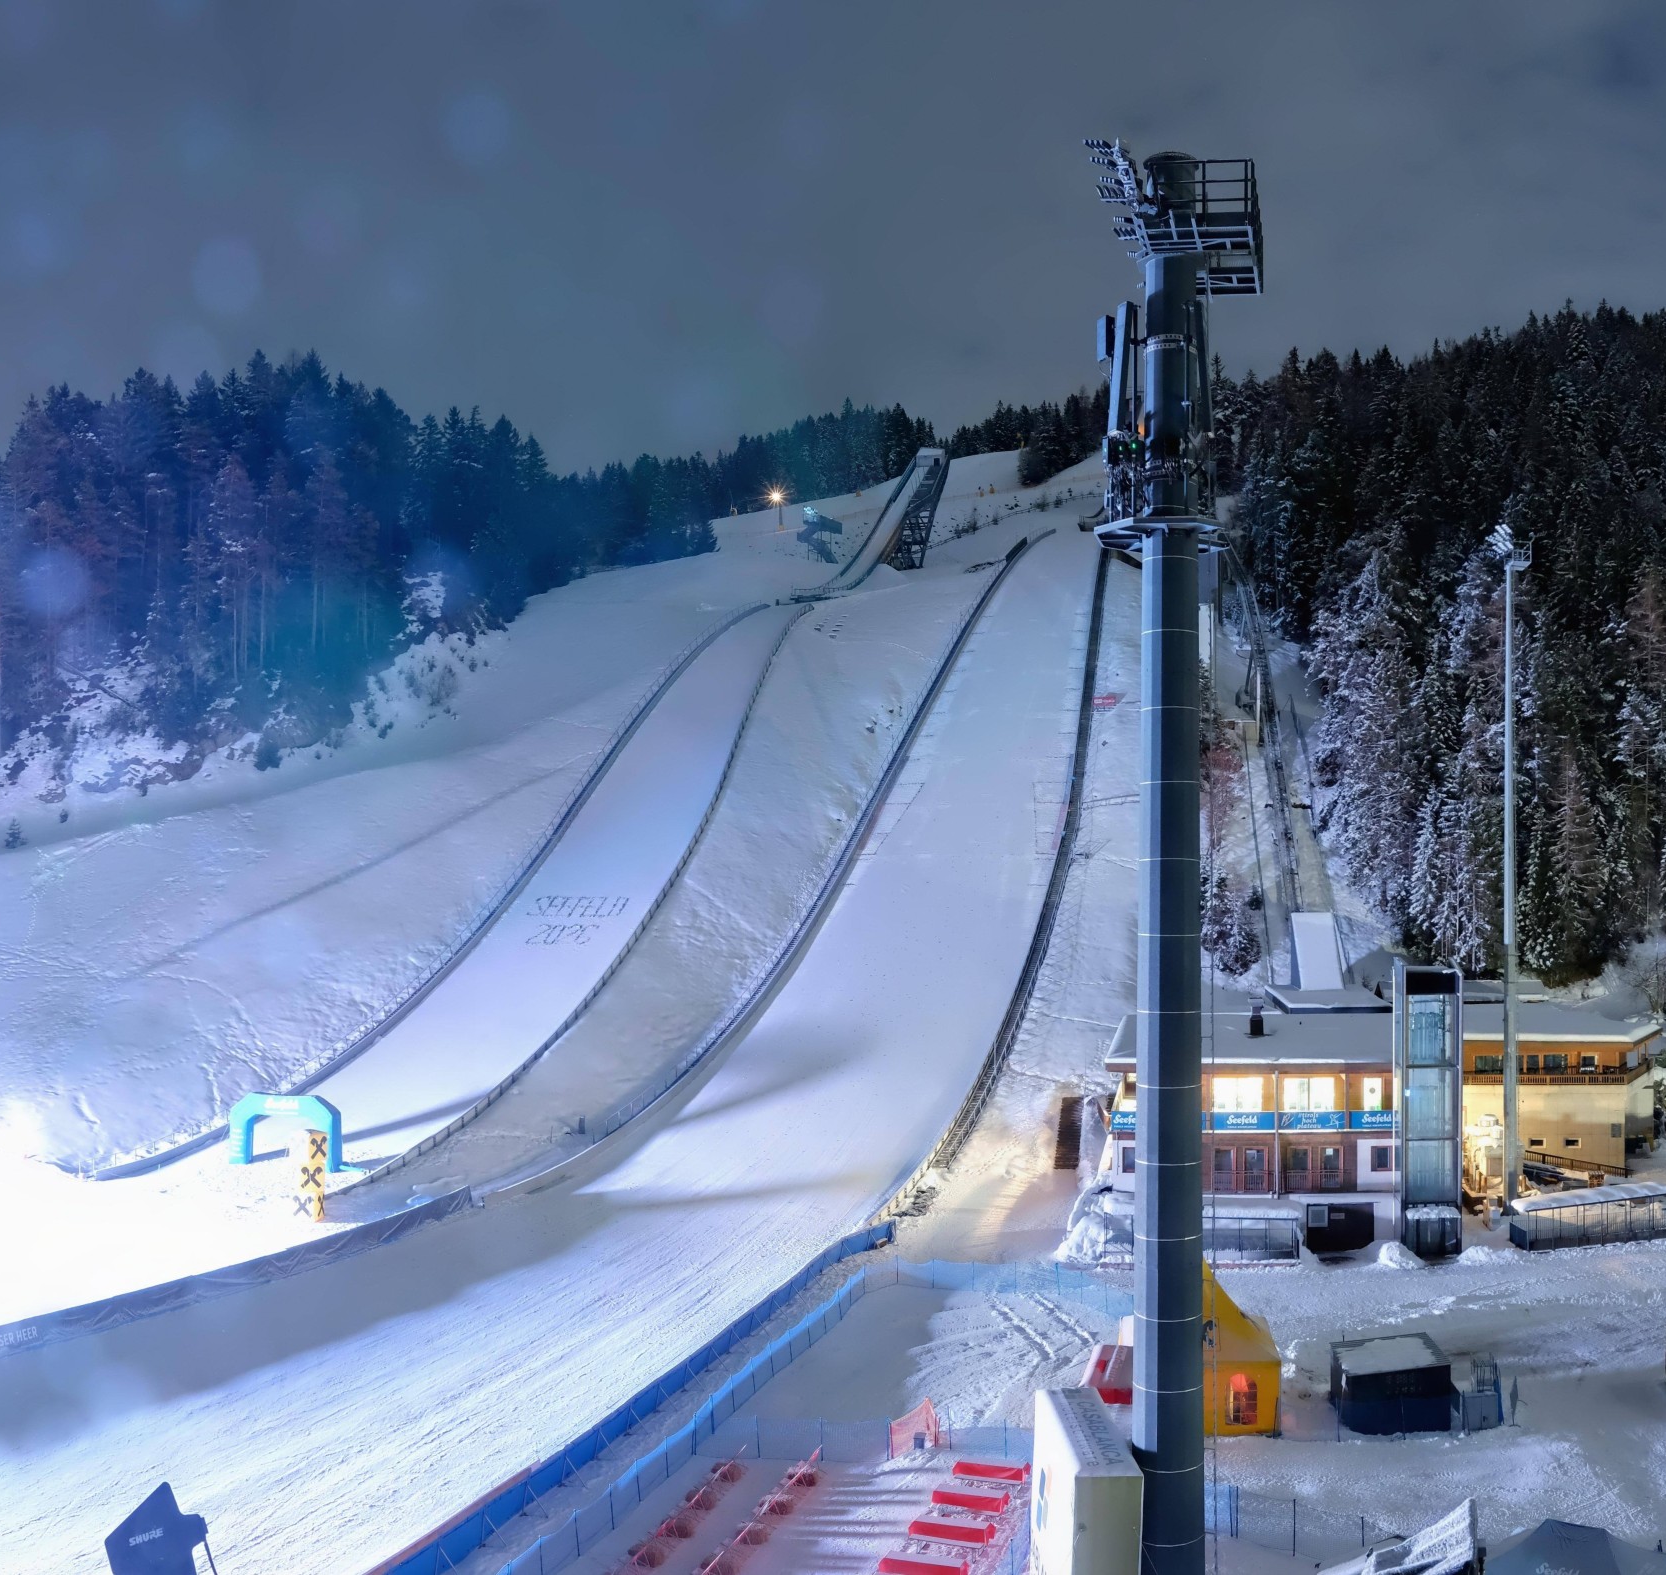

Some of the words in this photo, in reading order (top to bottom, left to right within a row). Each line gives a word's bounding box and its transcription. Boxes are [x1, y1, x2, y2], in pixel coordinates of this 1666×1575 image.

[1113, 1114, 1136, 1125] Seefe
[1227, 1114, 1258, 1126] Seefeld
[1362, 1113, 1392, 1124] Seefeld
[16, 1326, 38, 1342] HEER
[1077, 1401, 1125, 1466] CASABLANCA
[129, 1528, 163, 1547] SHURE
